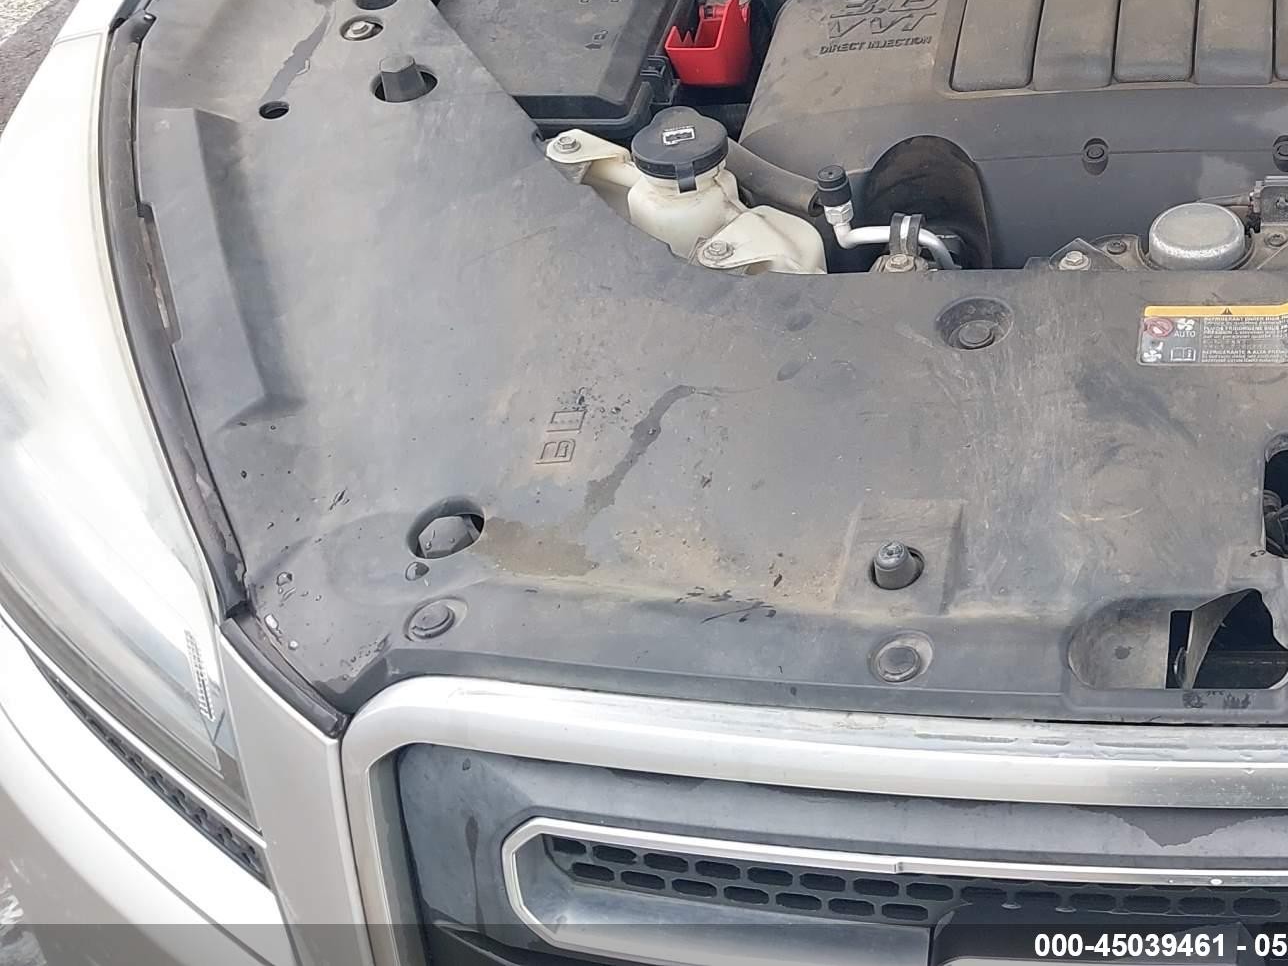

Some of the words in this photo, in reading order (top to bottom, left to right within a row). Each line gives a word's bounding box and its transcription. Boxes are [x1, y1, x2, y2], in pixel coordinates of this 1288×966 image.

[828, 13, 937, 39] VVT
[819, 41, 867, 55] DIRECT
[867, 35, 933, 50] INJECTION
[1174, 330, 1196, 338] AUTO
